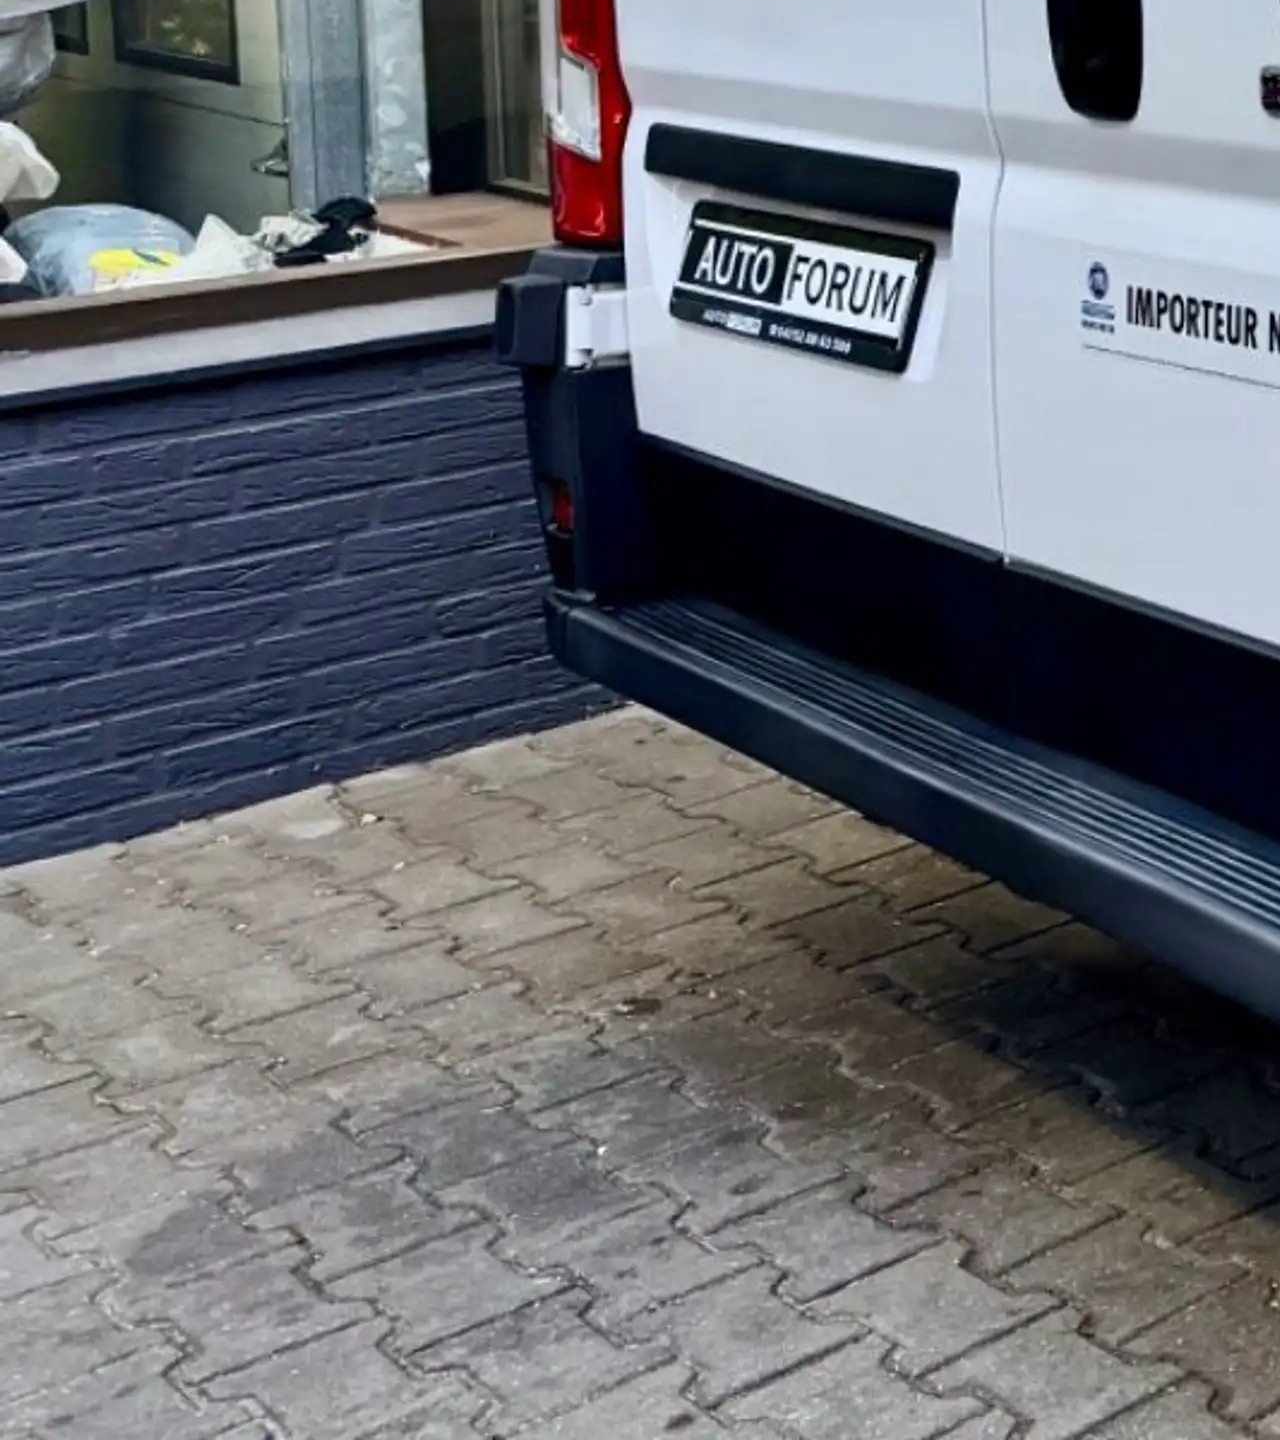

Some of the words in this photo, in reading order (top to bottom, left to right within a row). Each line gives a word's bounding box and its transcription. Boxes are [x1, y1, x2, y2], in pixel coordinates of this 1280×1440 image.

[694, 234, 776, 295] AUTO
[786, 254, 908, 323] FORUM
[1126, 284, 1258, 350] IMPORTEUR
